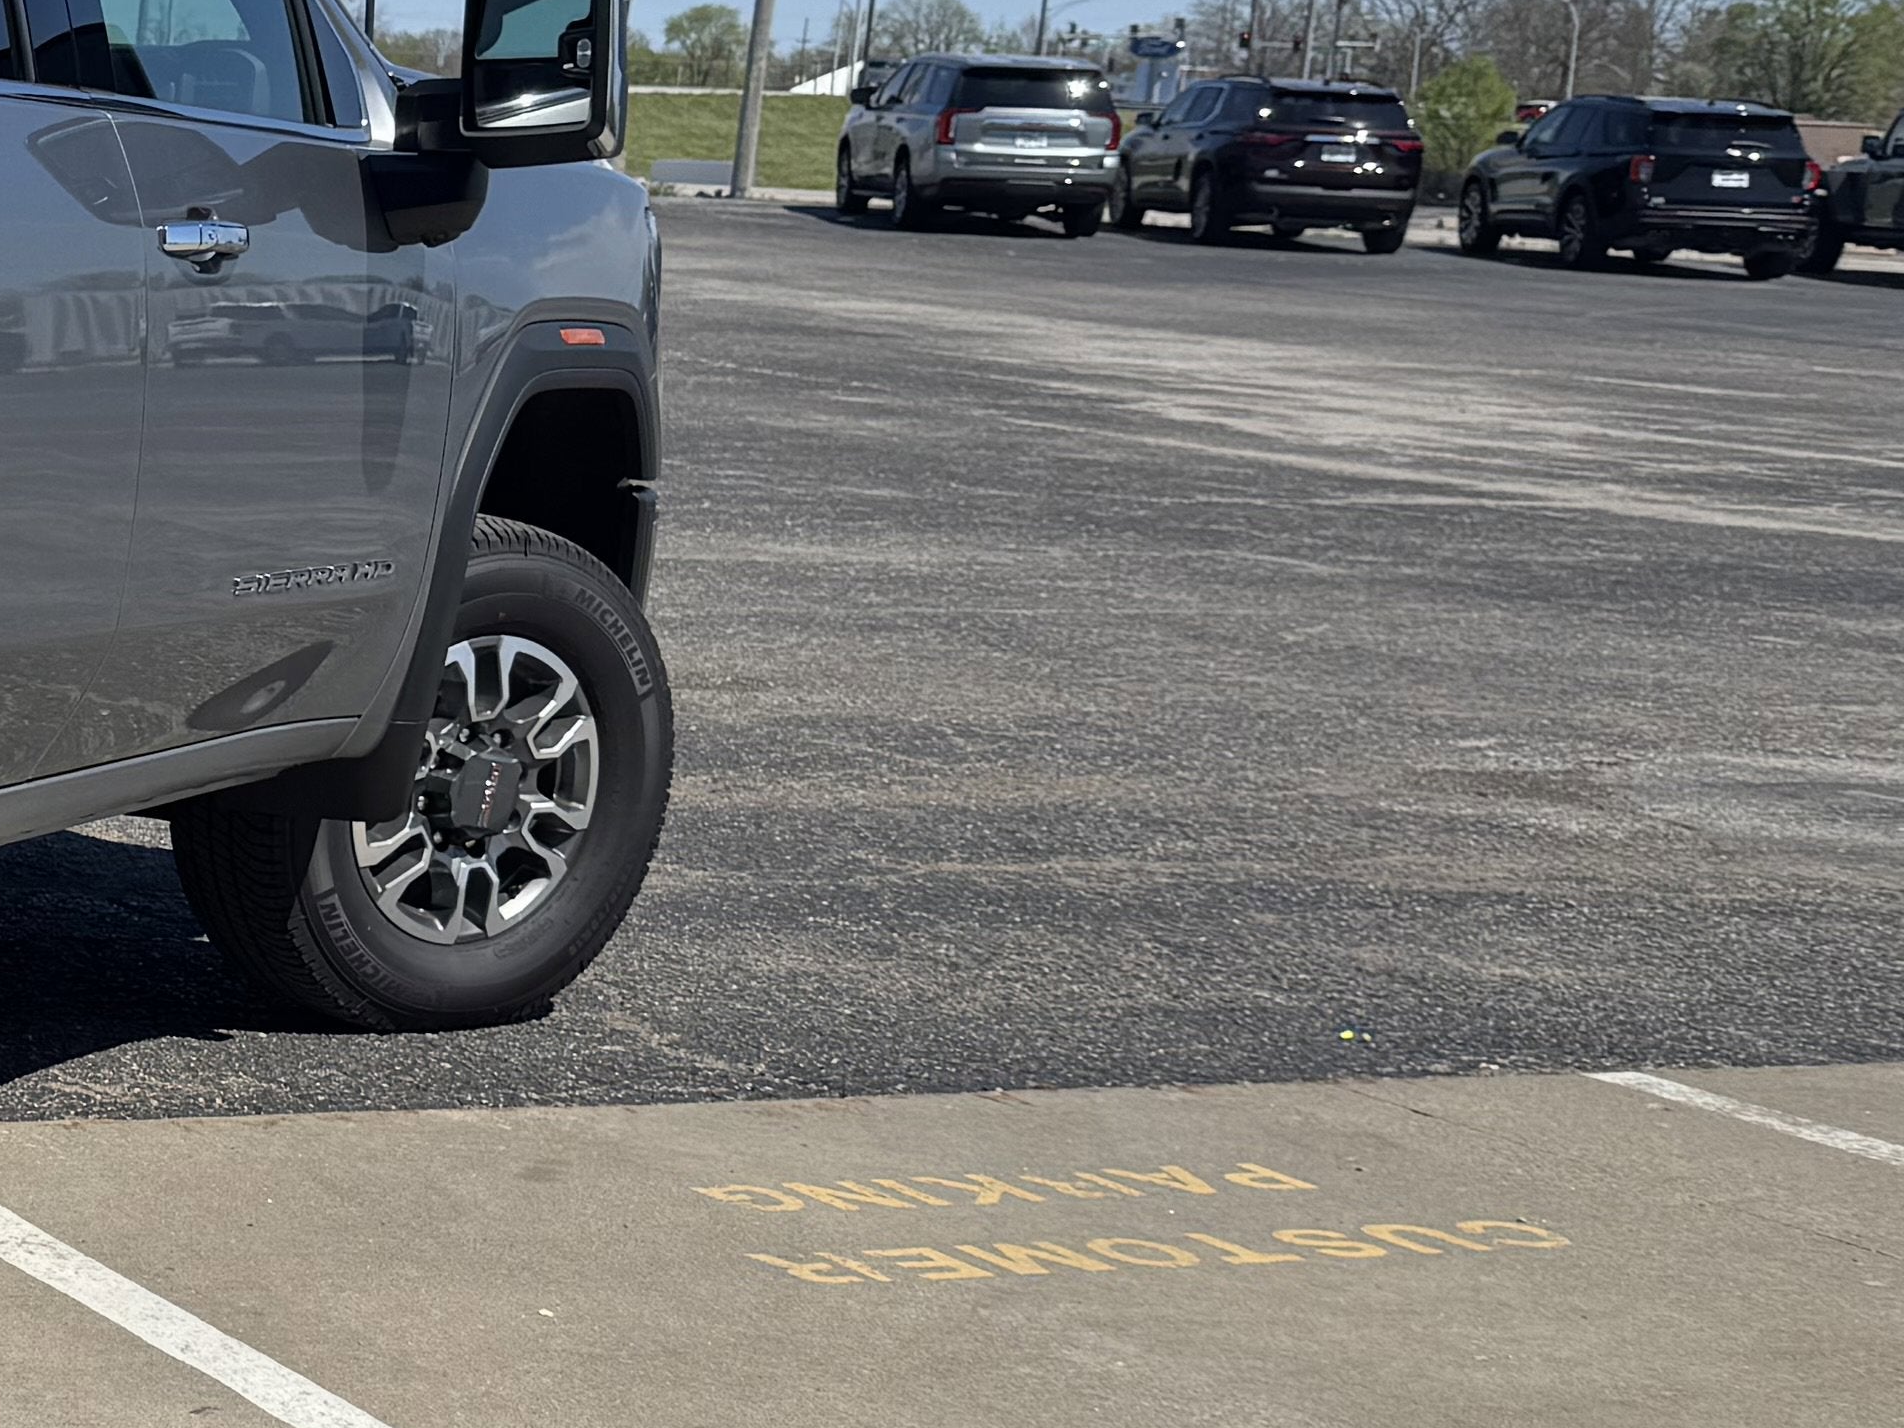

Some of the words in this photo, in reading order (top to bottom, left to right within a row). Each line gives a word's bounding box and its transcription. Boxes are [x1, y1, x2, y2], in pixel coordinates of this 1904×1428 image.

[232, 563, 349, 596] SIERRA
[575, 587, 651, 687] MICHELIN
[690, 1161, 1320, 1213] PARKING
[744, 1218, 1573, 1284] CUSTOMER
